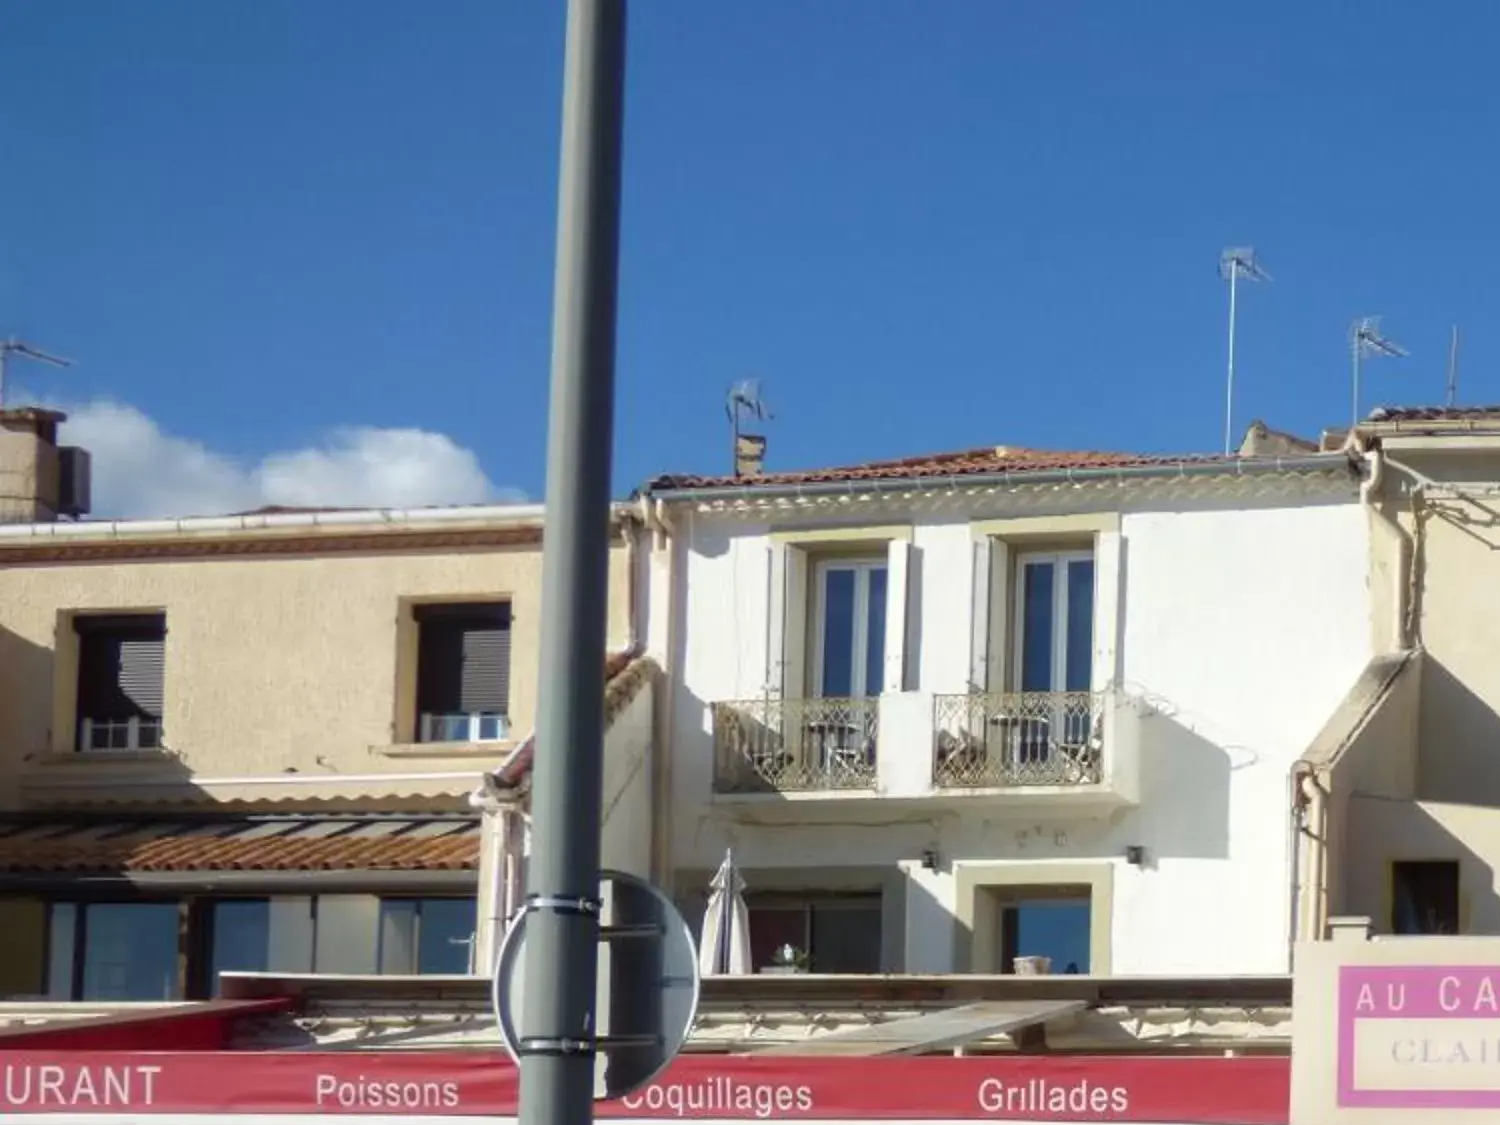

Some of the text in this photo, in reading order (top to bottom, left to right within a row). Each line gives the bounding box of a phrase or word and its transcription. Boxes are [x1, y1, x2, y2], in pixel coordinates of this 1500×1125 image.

[1355, 983, 1406, 1011] AU
[6, 1064, 162, 1105] URANT
[316, 1074, 460, 1107] Poissons
[978, 1078, 1129, 1112] Grillades
